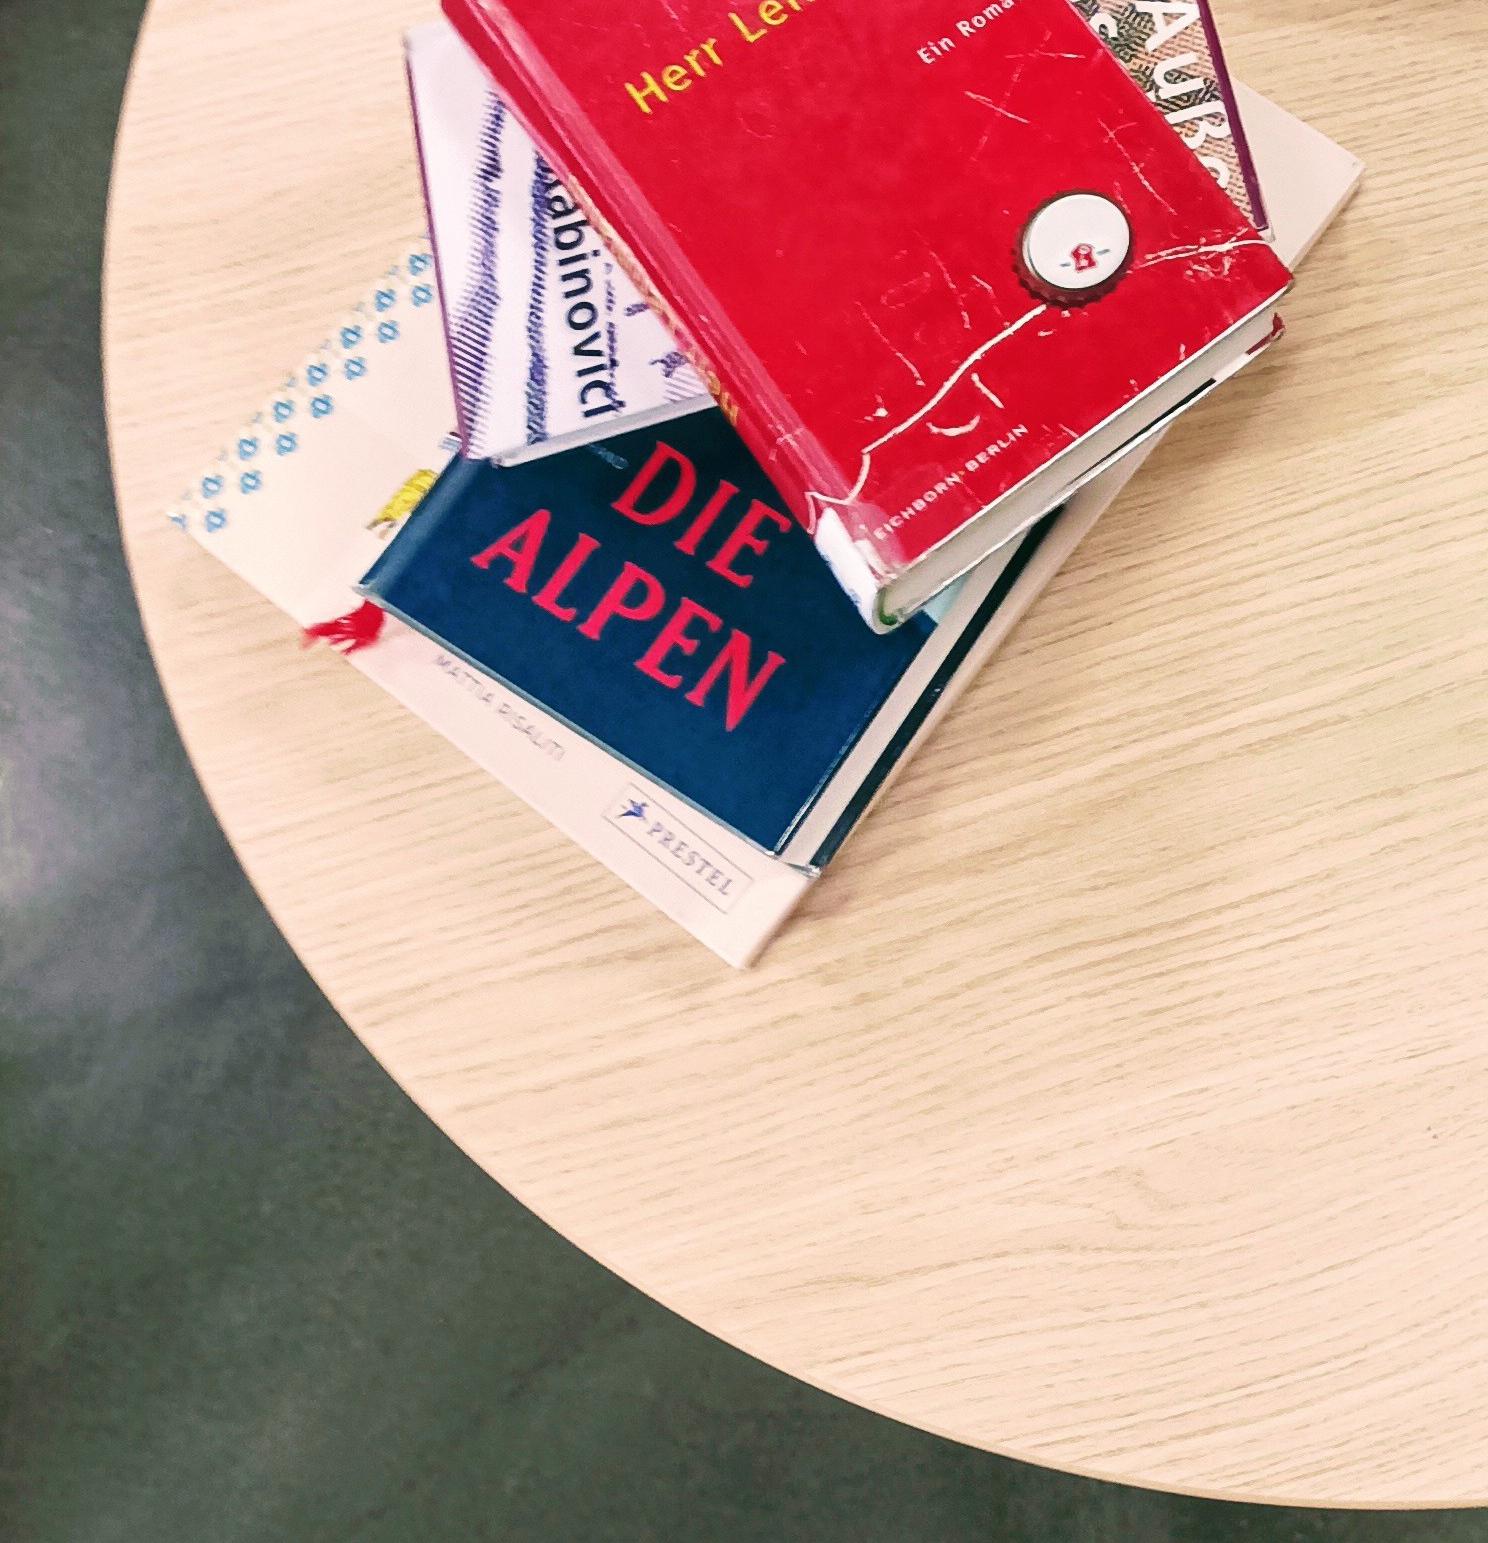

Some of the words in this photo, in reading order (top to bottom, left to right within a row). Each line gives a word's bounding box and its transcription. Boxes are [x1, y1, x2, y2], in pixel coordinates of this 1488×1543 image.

[625, 38, 721, 113] Herr
[916, 37, 954, 63] Ein
[611, 441, 791, 587] DIE
[470, 509, 784, 730] ALPEN
[646, 821, 732, 895] PRESTEL
